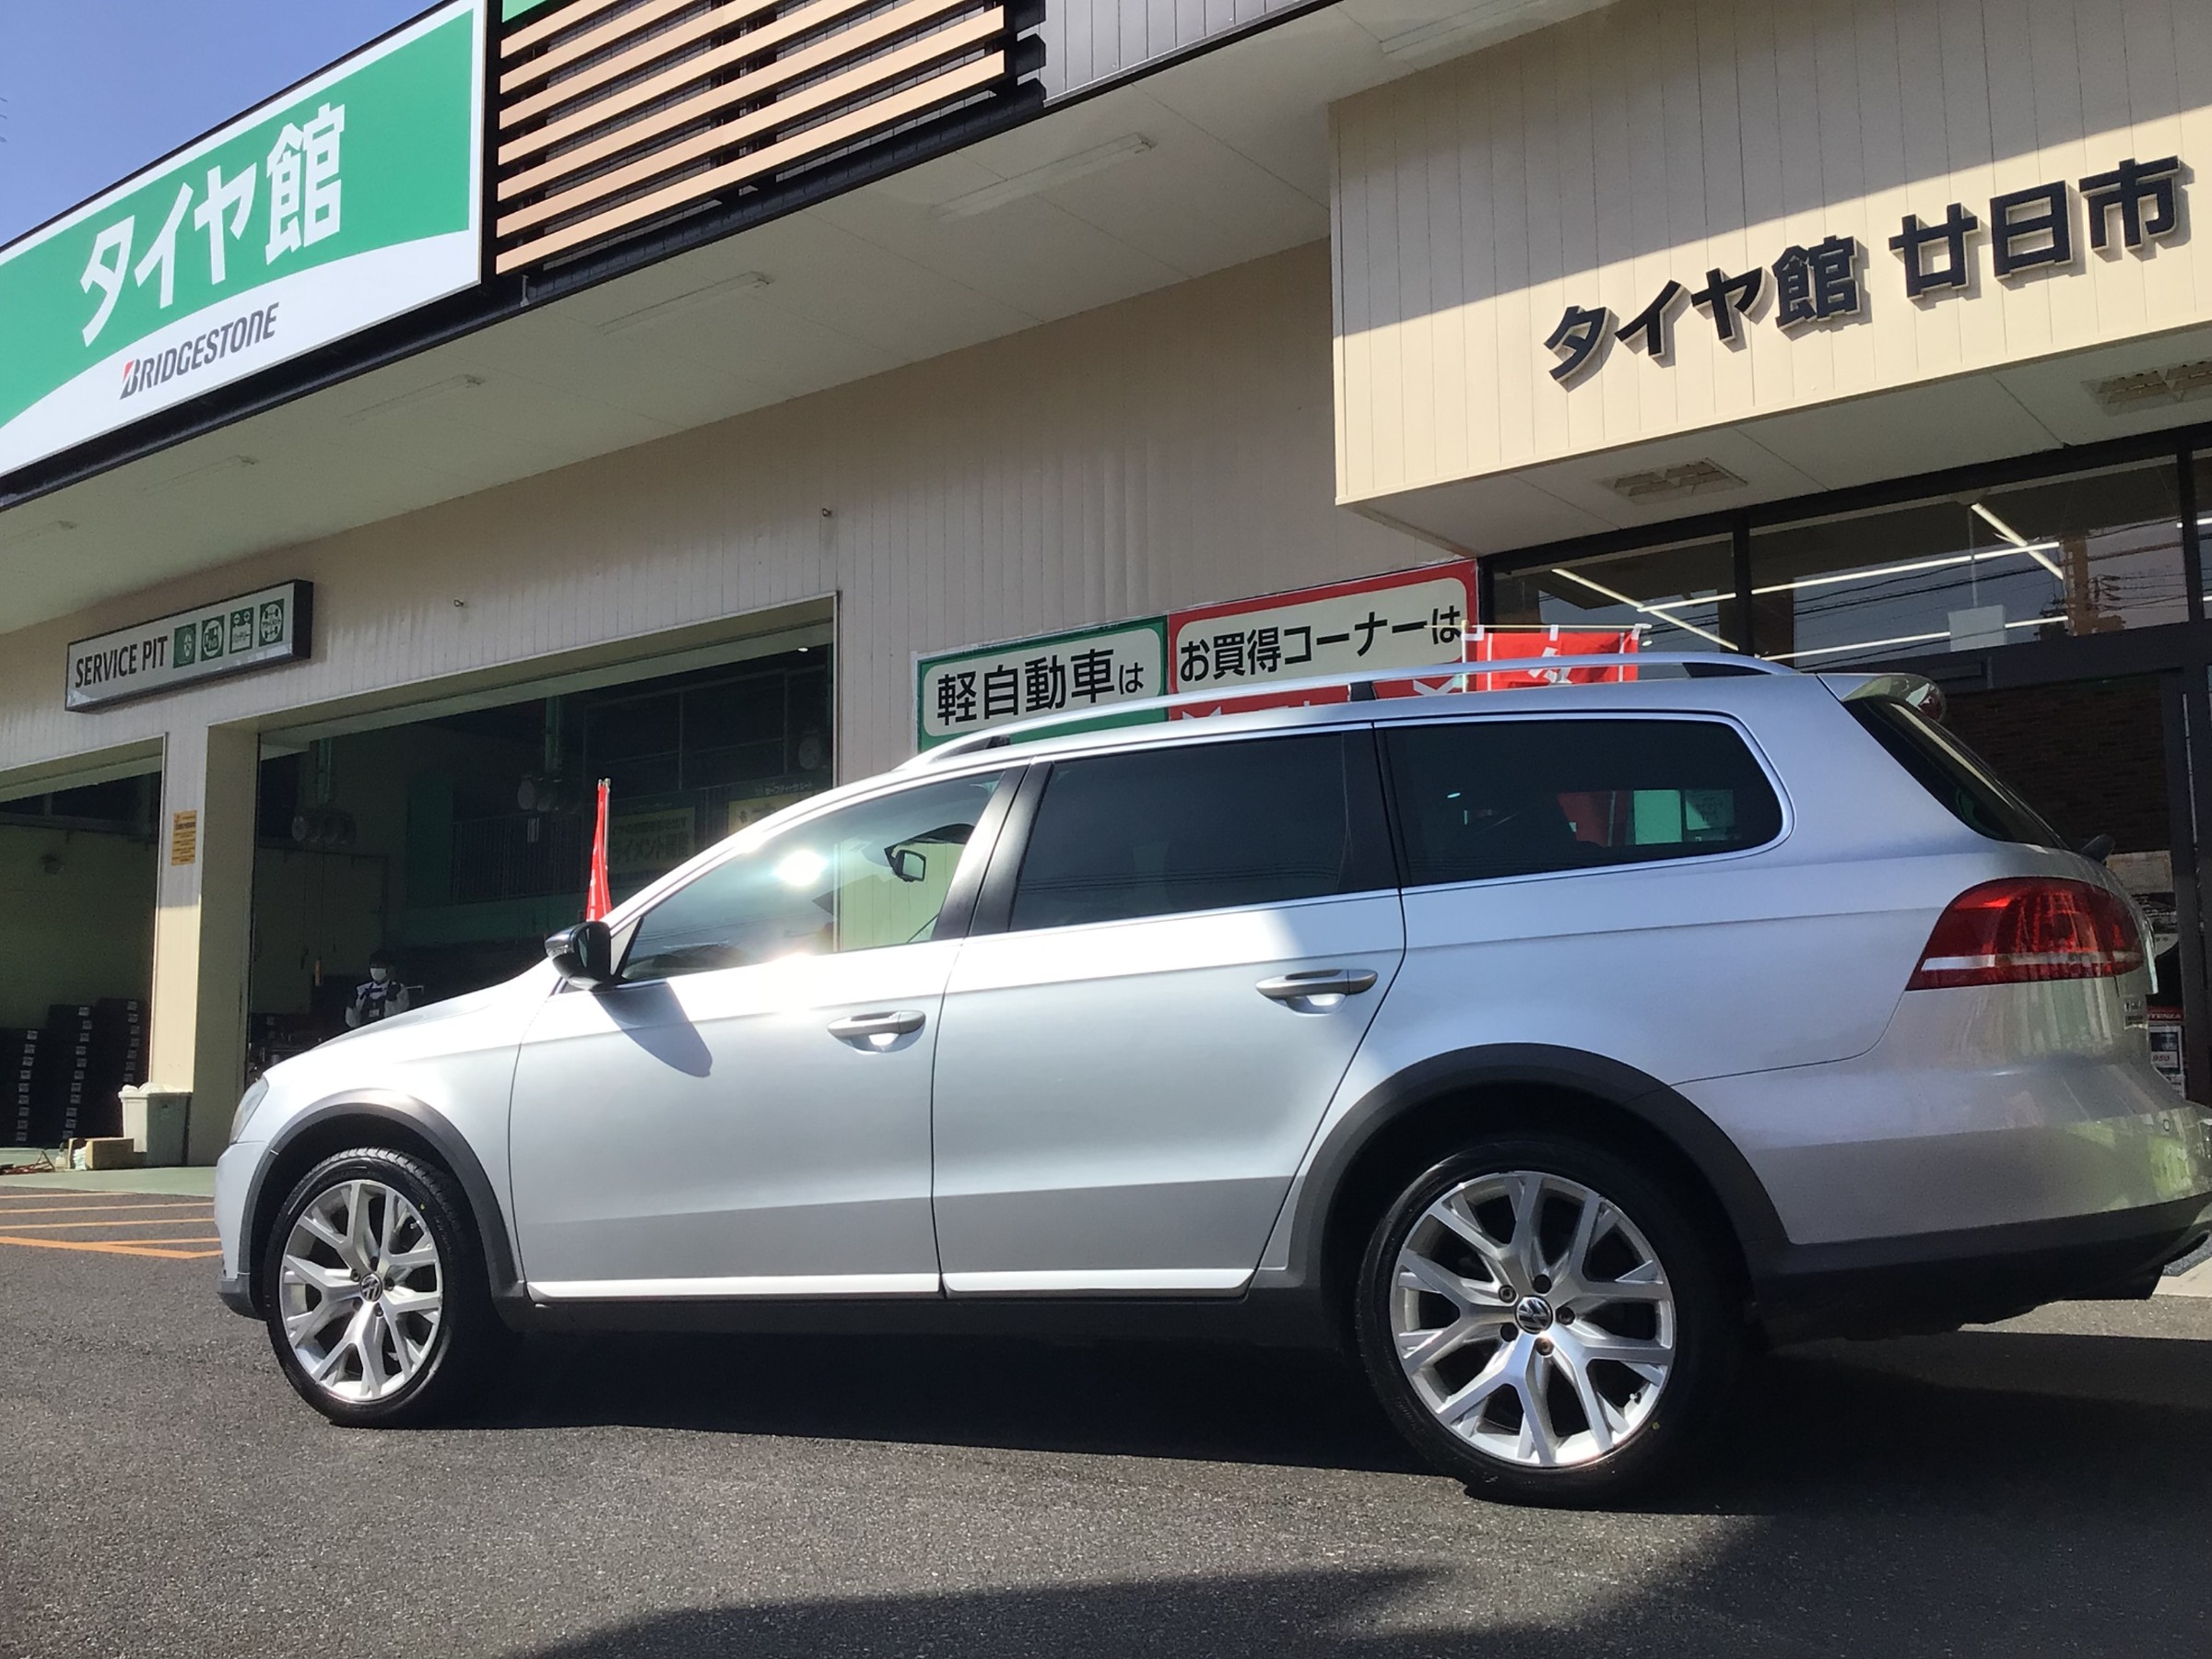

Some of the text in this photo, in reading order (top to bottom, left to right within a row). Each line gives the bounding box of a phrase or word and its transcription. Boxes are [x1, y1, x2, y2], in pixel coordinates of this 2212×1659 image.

[80, 101, 346, 347] タイヤ館
[1543, 155, 2183, 384] タイヤ館 廿日市
[119, 302, 279, 400] BRIDGESTONE
[75, 636, 168, 688] SERVICE PIT
[936, 648, 1145, 726] 軽自動車は
[1180, 605, 1462, 682] お買得コーナーは
